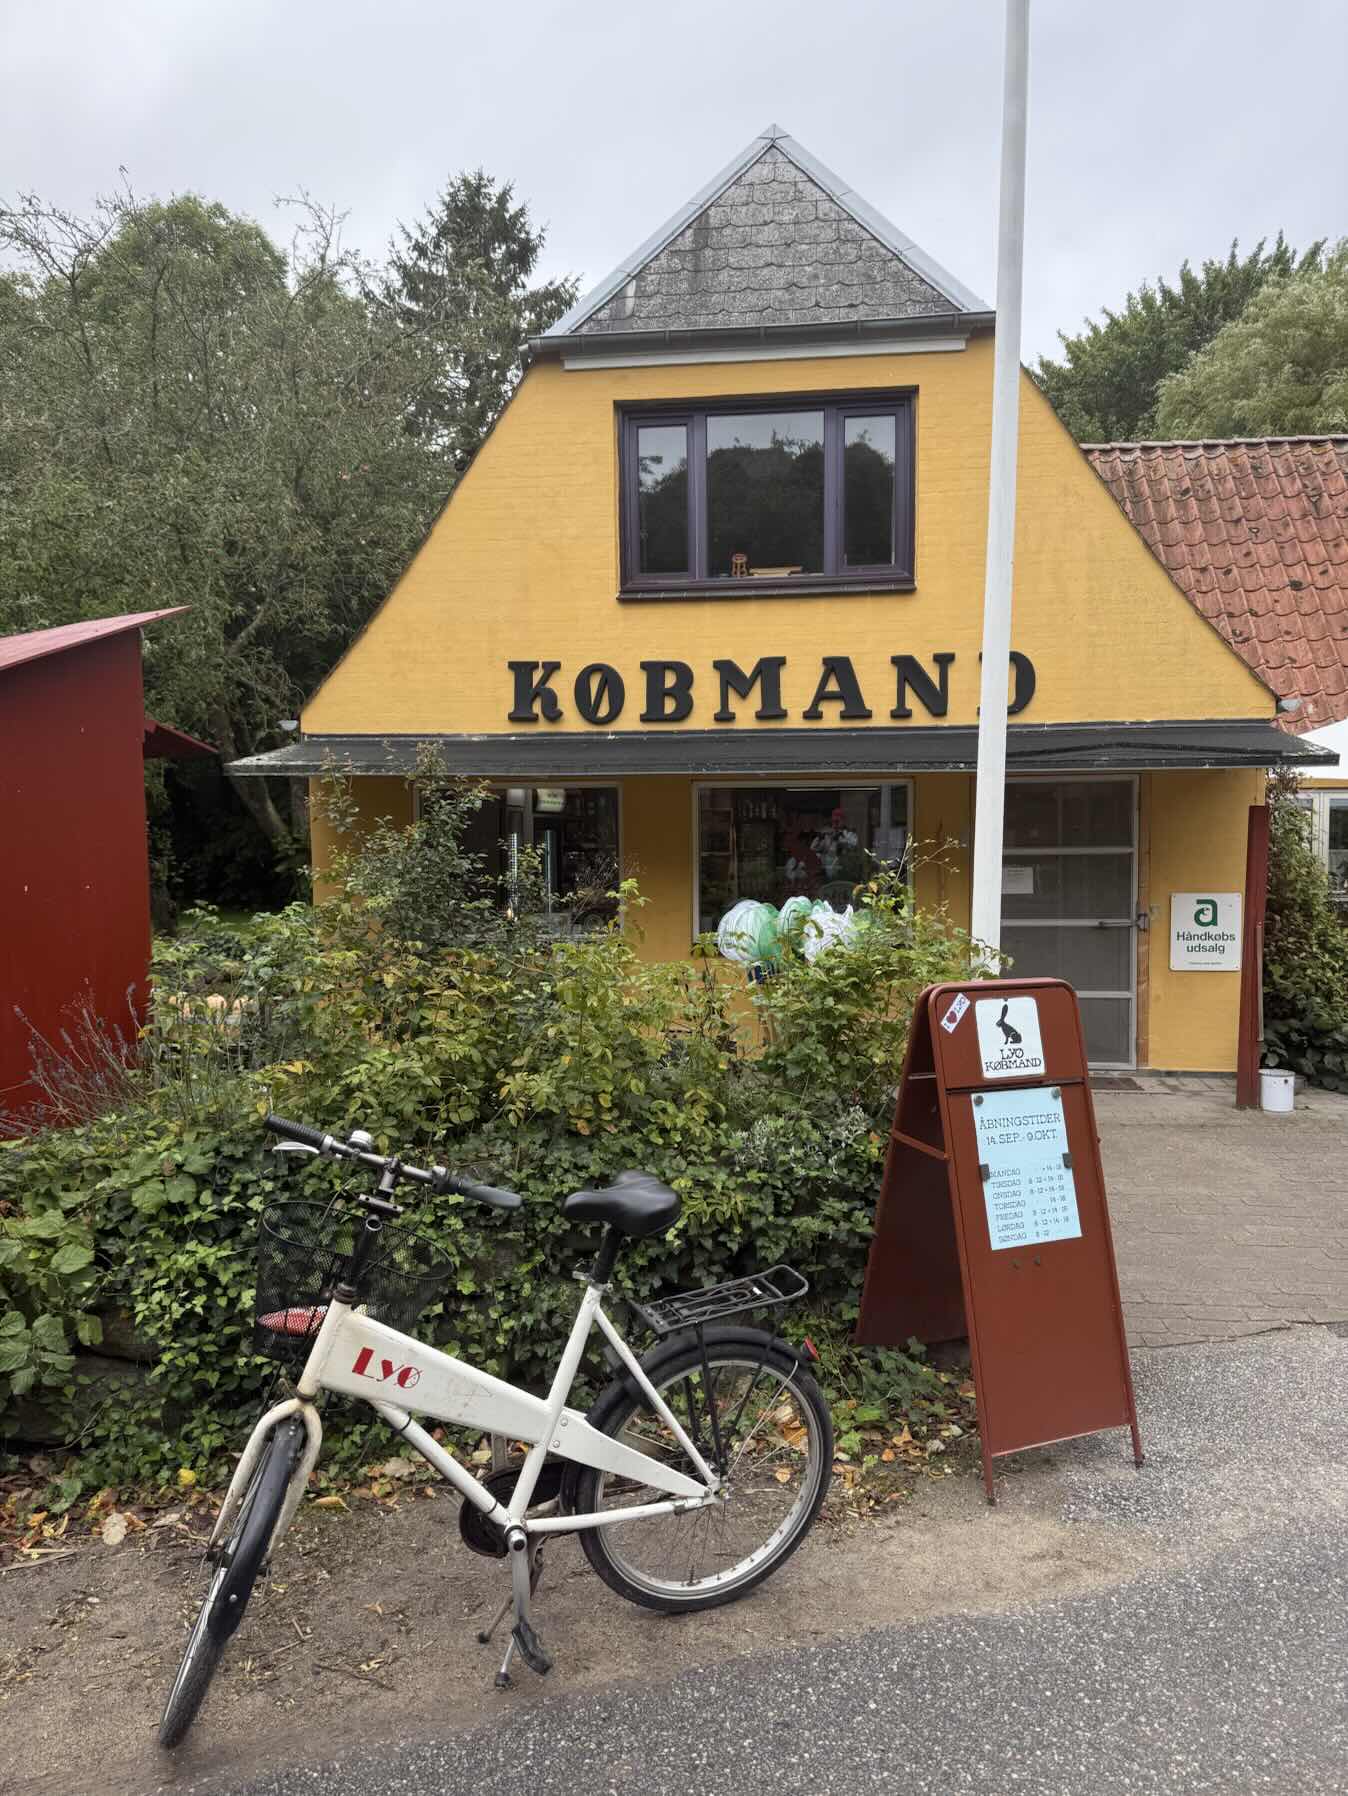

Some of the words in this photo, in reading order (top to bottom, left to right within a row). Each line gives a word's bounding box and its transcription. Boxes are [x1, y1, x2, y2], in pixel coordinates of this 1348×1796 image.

[508, 651, 1036, 725] KØBMAND
[1176, 931, 1236, 941] Håndkøbs
[1186, 943, 1226, 954] udsalg
[985, 1058, 1041, 1071] KØBMAND
[979, 1112, 1061, 1130] ÅBNINGSTIDER
